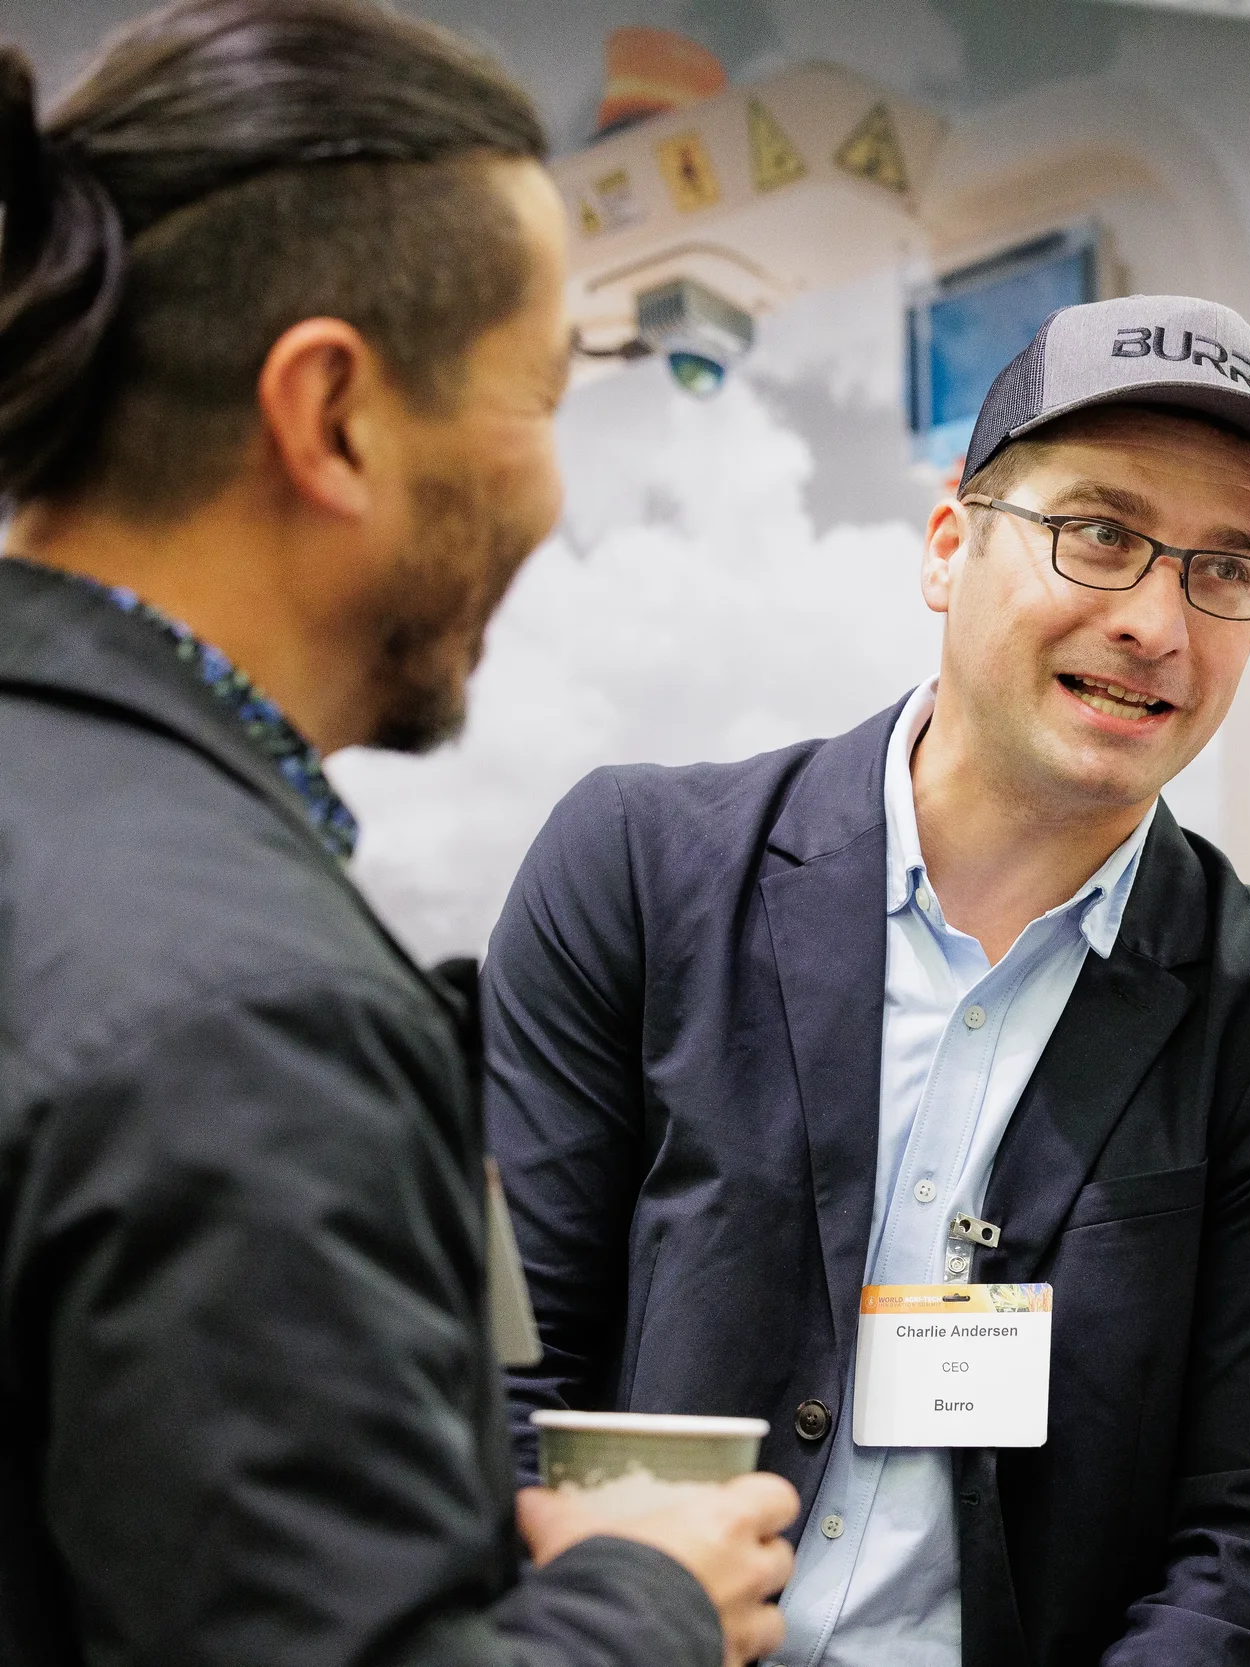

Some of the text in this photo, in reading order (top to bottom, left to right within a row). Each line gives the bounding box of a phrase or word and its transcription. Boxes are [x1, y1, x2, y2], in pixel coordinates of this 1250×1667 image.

[896, 1325, 1018, 1337] Charlie Andersen
[942, 1361, 969, 1372] CEO
[934, 1399, 974, 1411] Burro
